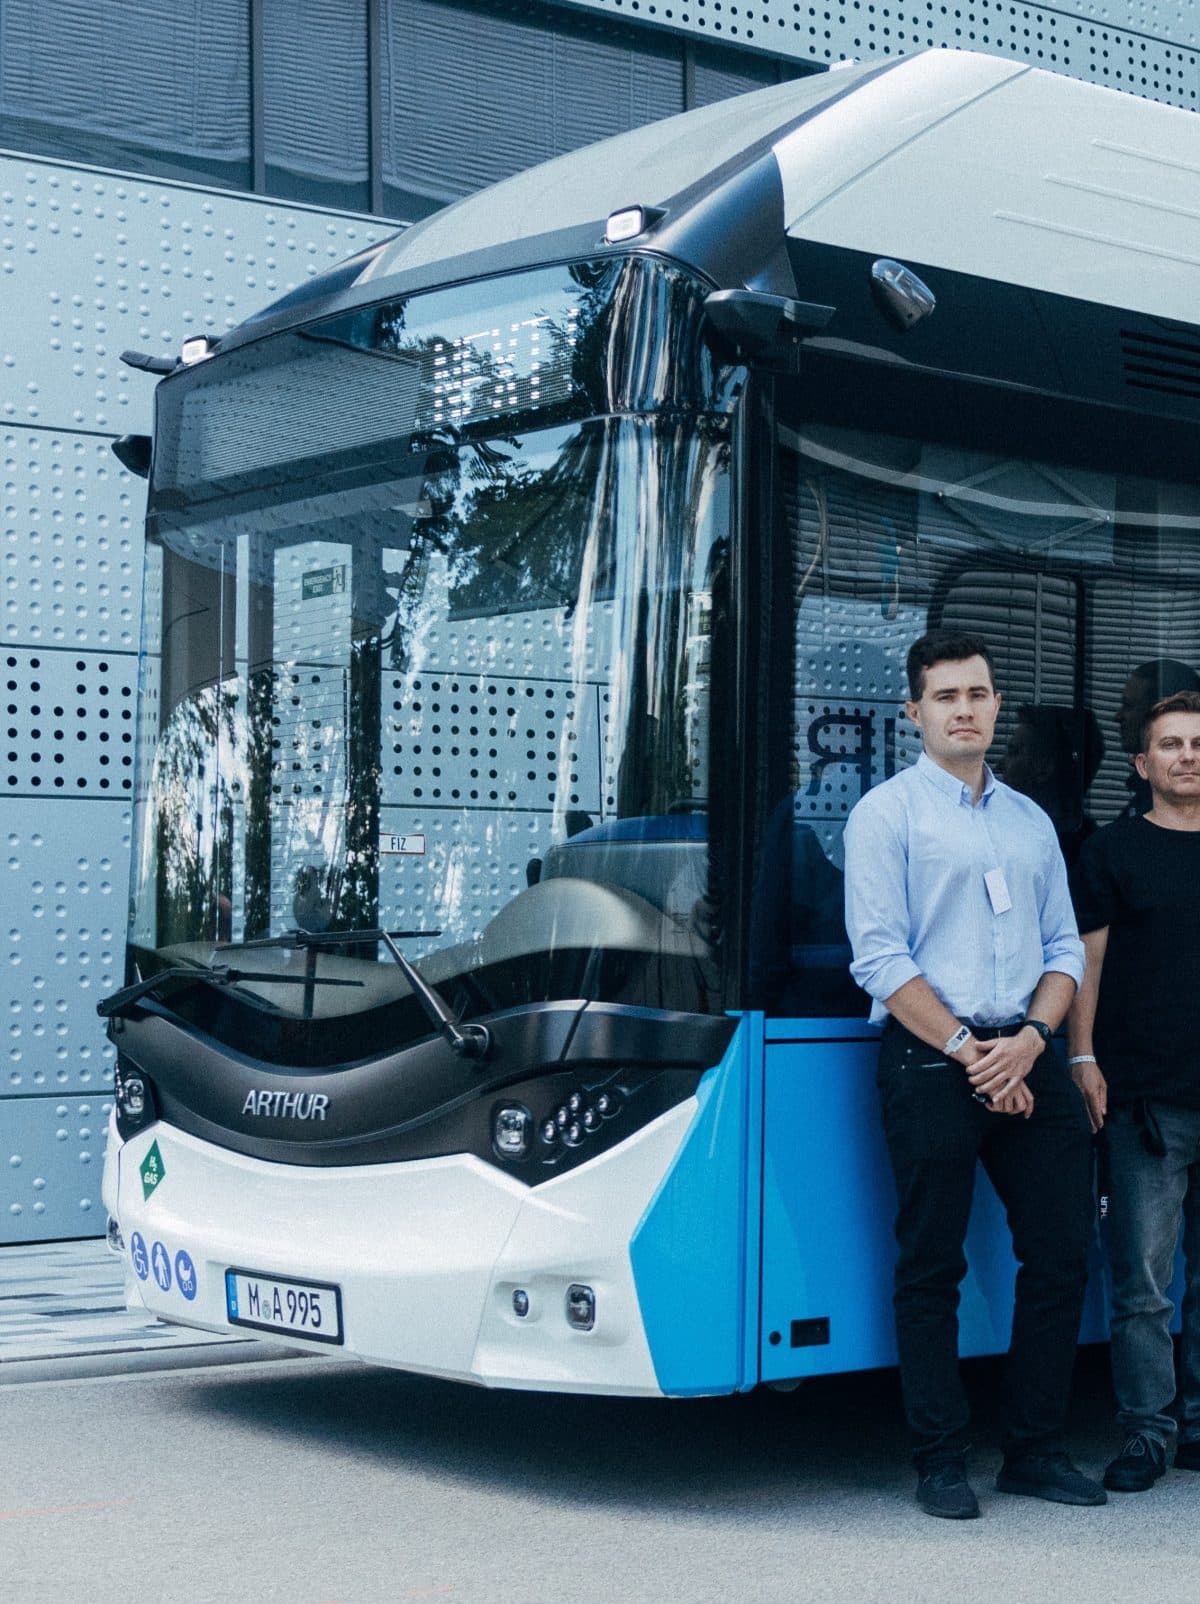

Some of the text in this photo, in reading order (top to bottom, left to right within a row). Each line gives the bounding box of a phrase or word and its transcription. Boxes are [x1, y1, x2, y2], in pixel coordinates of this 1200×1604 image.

[390, 836, 407, 851] FIZ
[241, 1089, 329, 1121] ARTHUR
[143, 1171, 159, 1185] GAS
[248, 1282, 260, 1317] M
